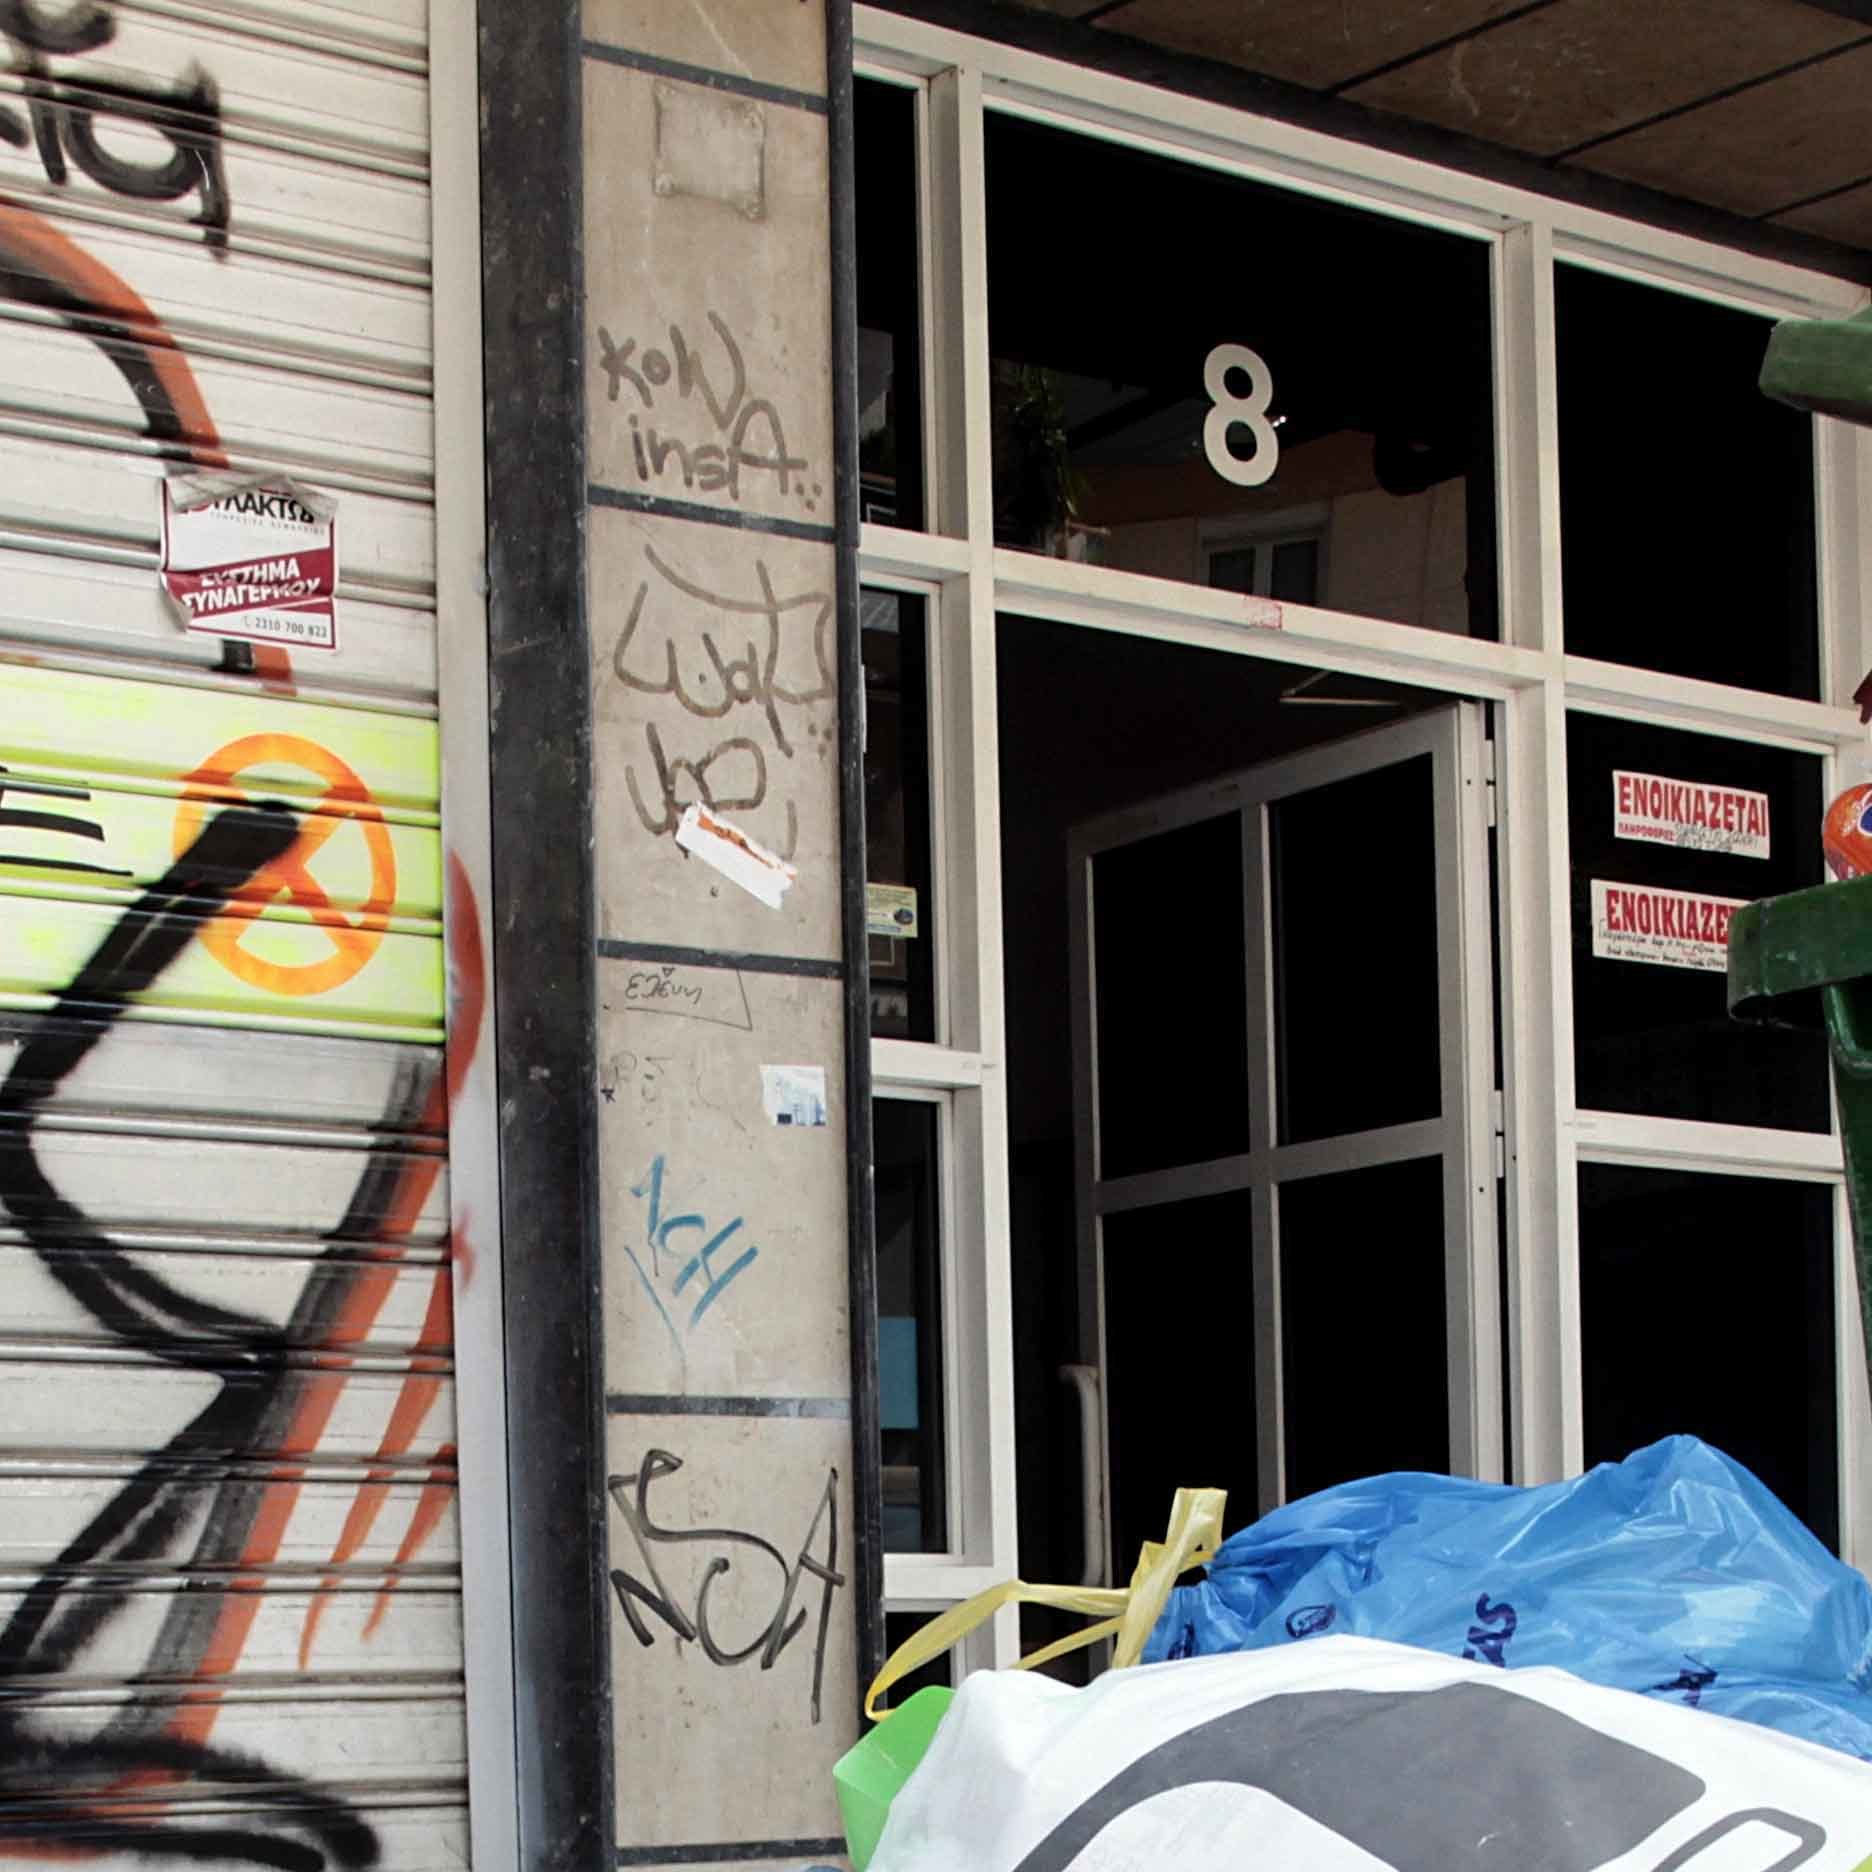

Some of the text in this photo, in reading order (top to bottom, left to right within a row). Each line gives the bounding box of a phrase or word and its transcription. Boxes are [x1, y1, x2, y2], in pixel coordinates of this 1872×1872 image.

[1203, 343, 1280, 487] 8
[1617, 775, 1767, 837] ΕΝΟΙΚΙΑΖΕΤΑΙ
[1606, 888, 1737, 945] ΕΝΟΙΚΙΑΖΕ
